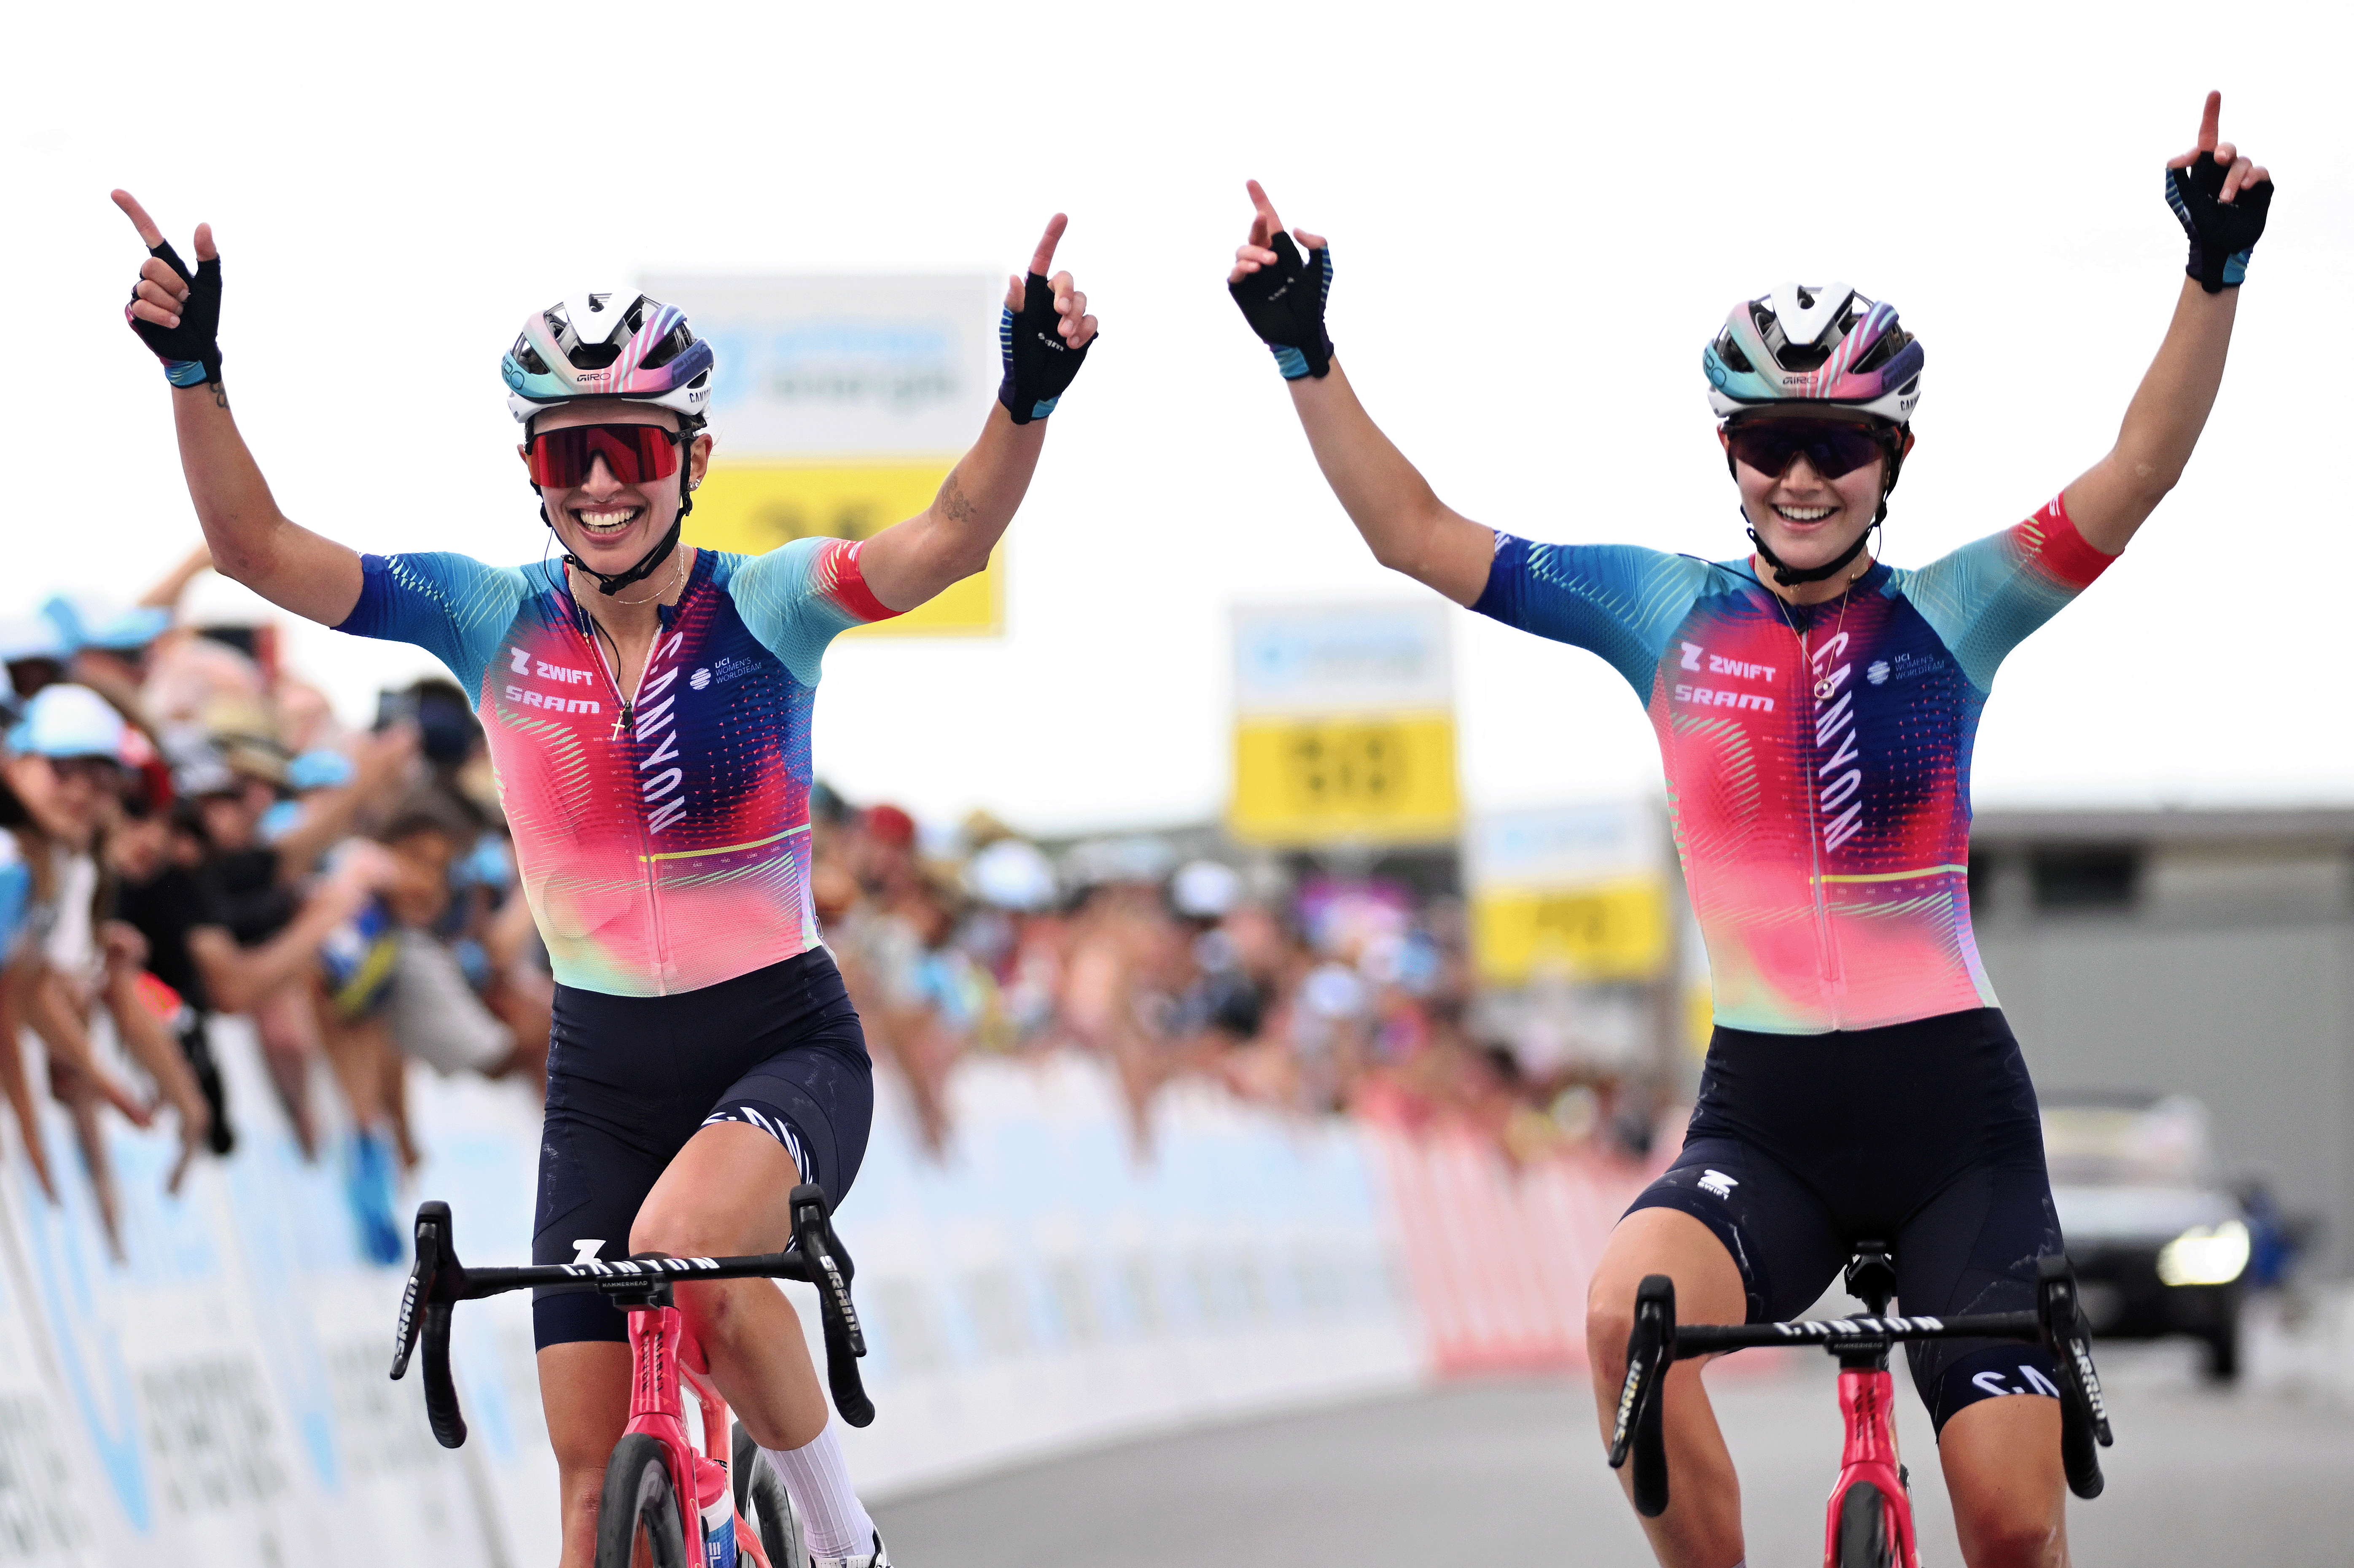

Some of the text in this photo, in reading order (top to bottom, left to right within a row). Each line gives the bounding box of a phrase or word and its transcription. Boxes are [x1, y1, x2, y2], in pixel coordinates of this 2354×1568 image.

[577, 372, 611, 382] GIRO
[1782, 376, 1819, 385] GIRO
[715, 656, 730, 669] UCI
[716, 656, 751, 676] WOMEN'S
[1709, 654, 1776, 682] ZWIFT
[1895, 652, 1910, 664] UCI
[537, 662, 593, 686] ZWIFT
[716, 662, 762, 684] WORLDTEAM
[506, 687, 600, 714] SRAM
[1675, 684, 1774, 712] SRAM
[636, 631, 687, 836] CANYON
[1812, 631, 1863, 854] CANYON
[560, 1257, 720, 1277] CANYON
[820, 1255, 859, 1331] SRAM
[395, 1276, 419, 1358] SRAM
[1773, 1316, 1944, 1336] CANYON
